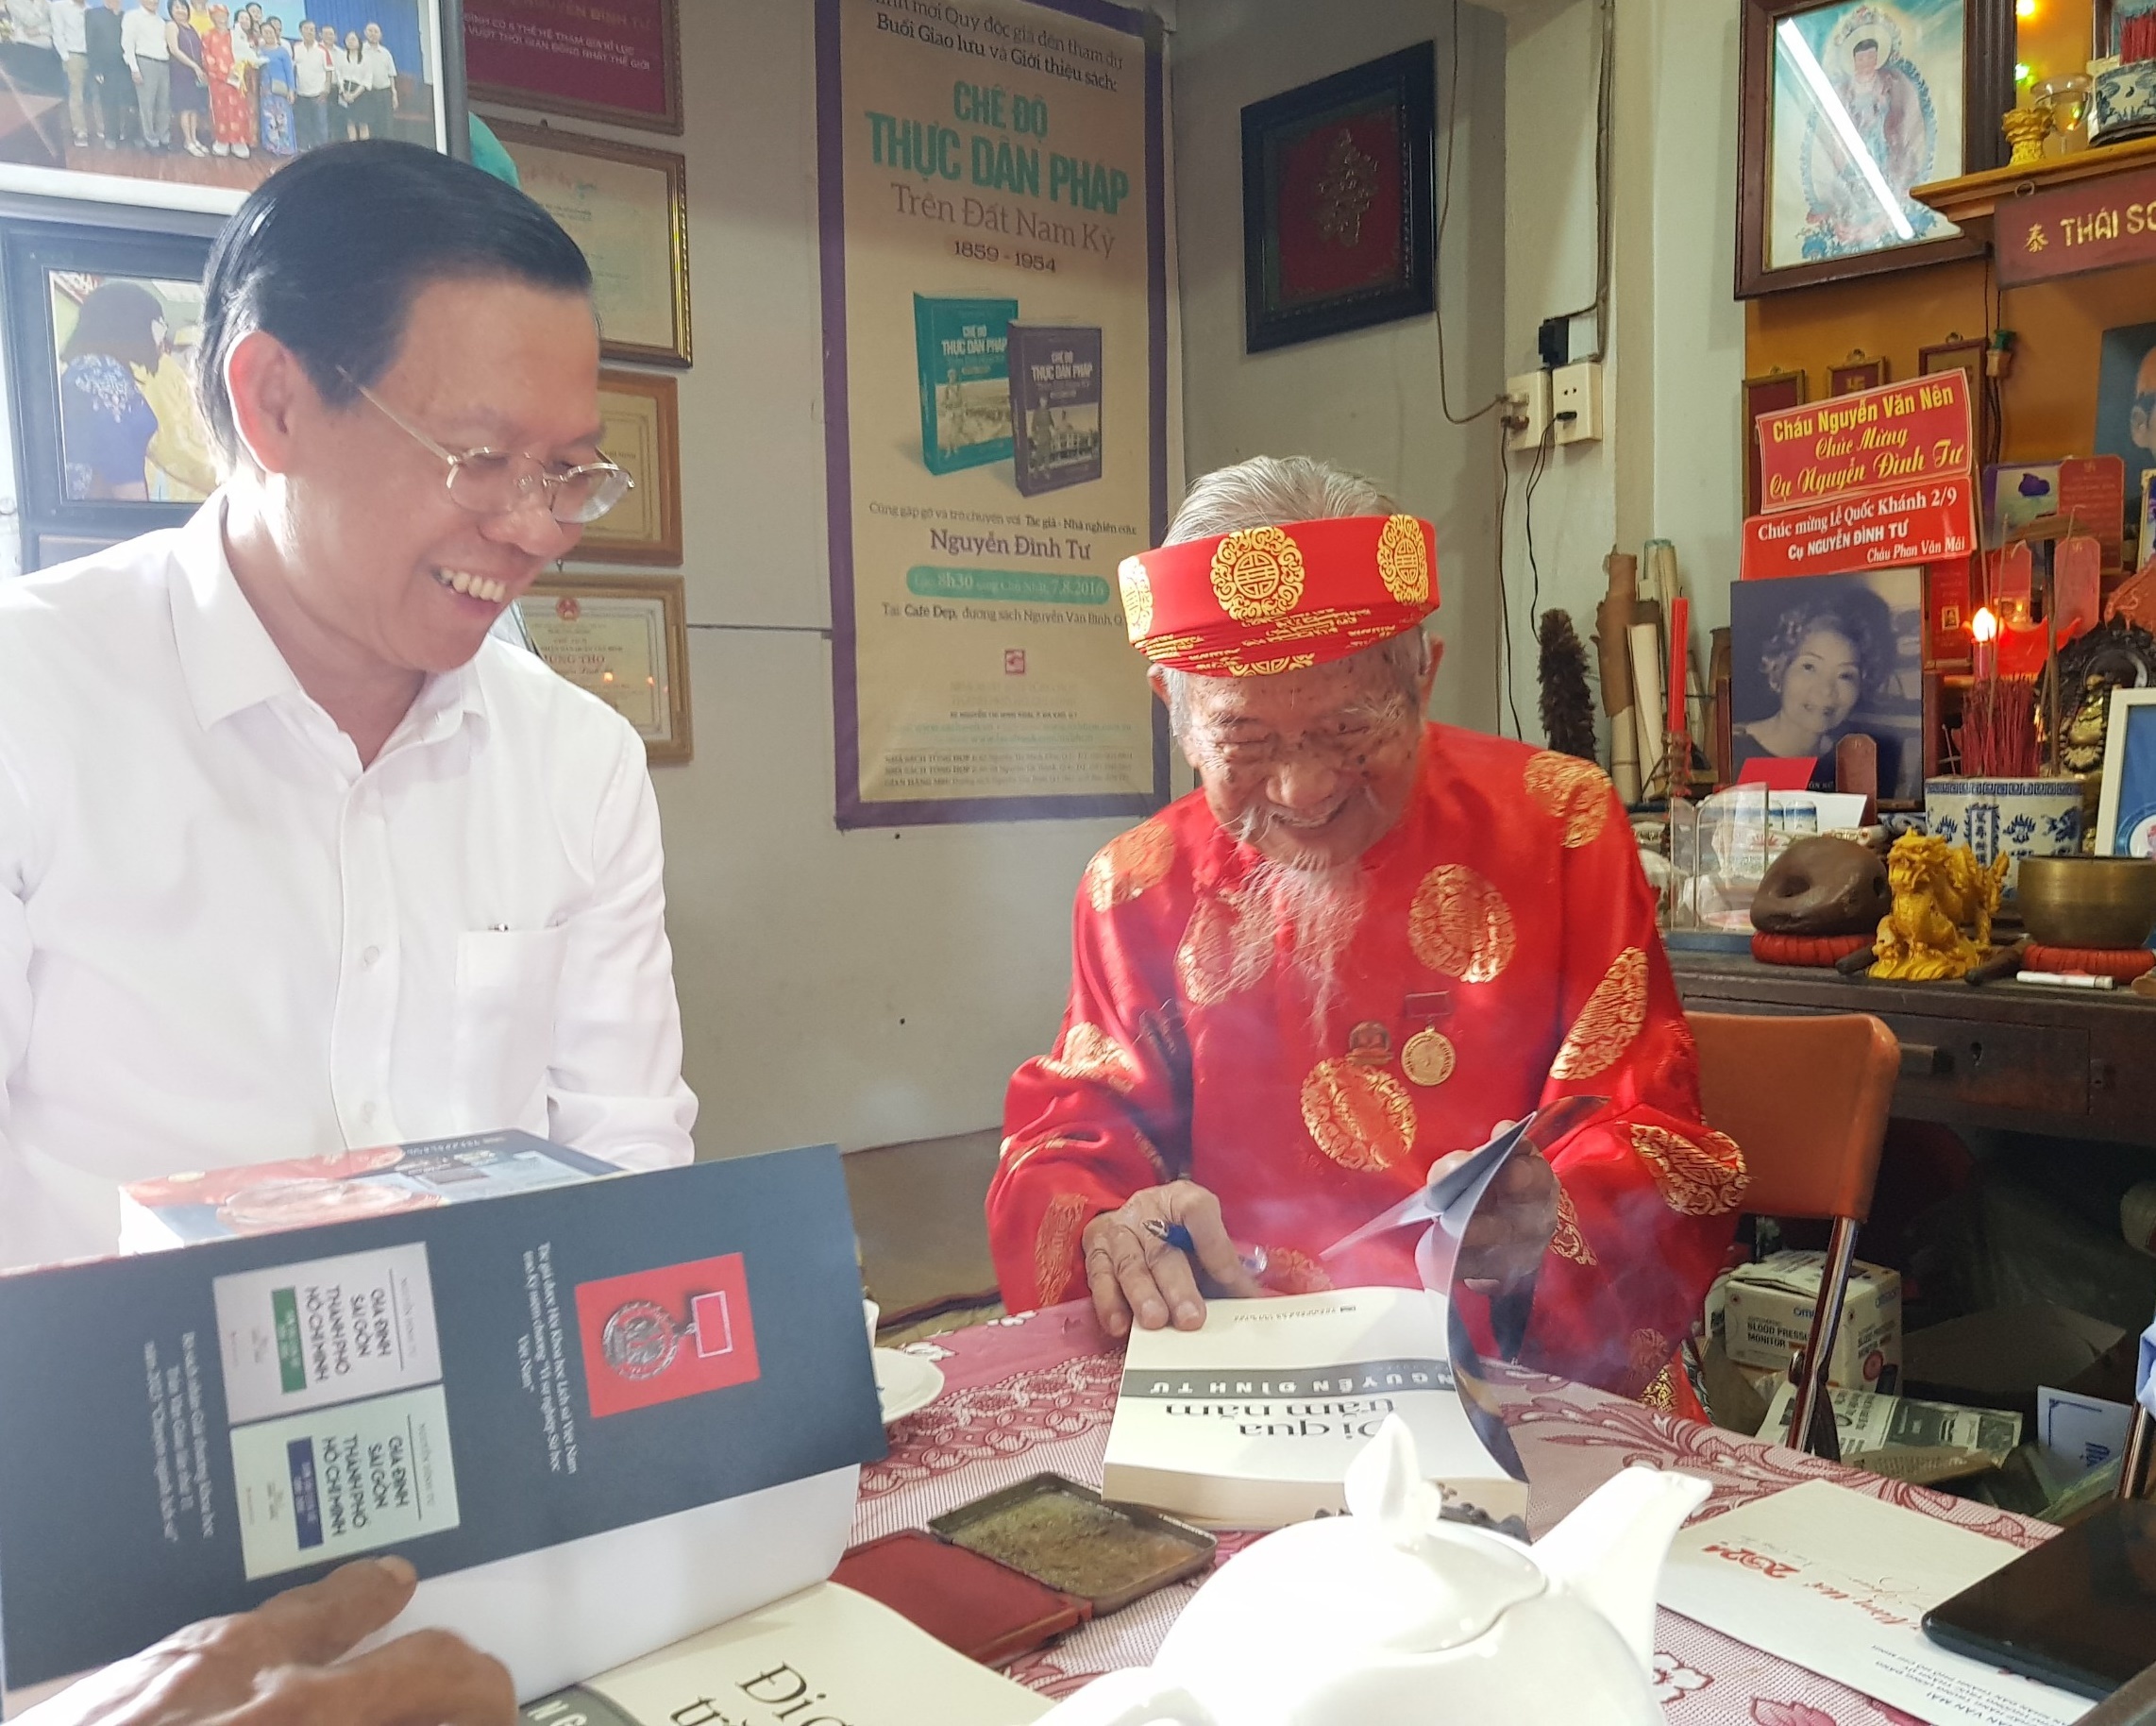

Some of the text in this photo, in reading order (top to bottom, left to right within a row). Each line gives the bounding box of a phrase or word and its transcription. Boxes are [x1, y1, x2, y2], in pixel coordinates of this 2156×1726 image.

[877, 12, 915, 39] Buổi
[918, 24, 954, 48] Giao
[957, 32, 985, 57] lưu
[989, 44, 1008, 62] và
[1011, 47, 1040, 70] Giới
[1044, 58, 1082, 82] thiệu
[953, 79, 1049, 139] CHẾ ĐỘ
[865, 110, 1129, 215] THỰC DÂN PHÁP
[891, 182, 956, 223] Trên
[963, 195, 1008, 233] Đất
[1017, 208, 1076, 248] Nam
[2061, 207, 2118, 246] THÁI
[954, 240, 999, 263] 1859
[1015, 252, 1056, 273] 1954
[1773, 384, 1954, 443] Cháu Nguyễn Văn Nên
[1815, 427, 1909, 461] Chúc Mừng
[1770, 438, 1965, 502] Cụ Nguyễn Đình Tư
[1759, 486, 1958, 542] Chúc mừng Lễ Quốc Khánh 2/9
[930, 527, 1091, 561] Nguyễn Đình Tư
[1788, 518, 1909, 562] Cụ NGUYỄN ĐÌNH TƯ
[1867, 546, 1891, 564] Cháu
[1894, 543, 1917, 559] Phan
[1921, 538, 1942, 555] Văn
[1023, 609, 1064, 625] Nguyễn
[1747, 1322, 1775, 1335] BLOOD
[1747, 1332, 1786, 1348] MONITOR
[1149, 1380, 1192, 1396] TƯ
[1209, 1379, 1297, 1396] ĐÌNH
[1166, 1397, 1394, 1420] trăm năm
[1238, 1417, 1331, 1439] qua
